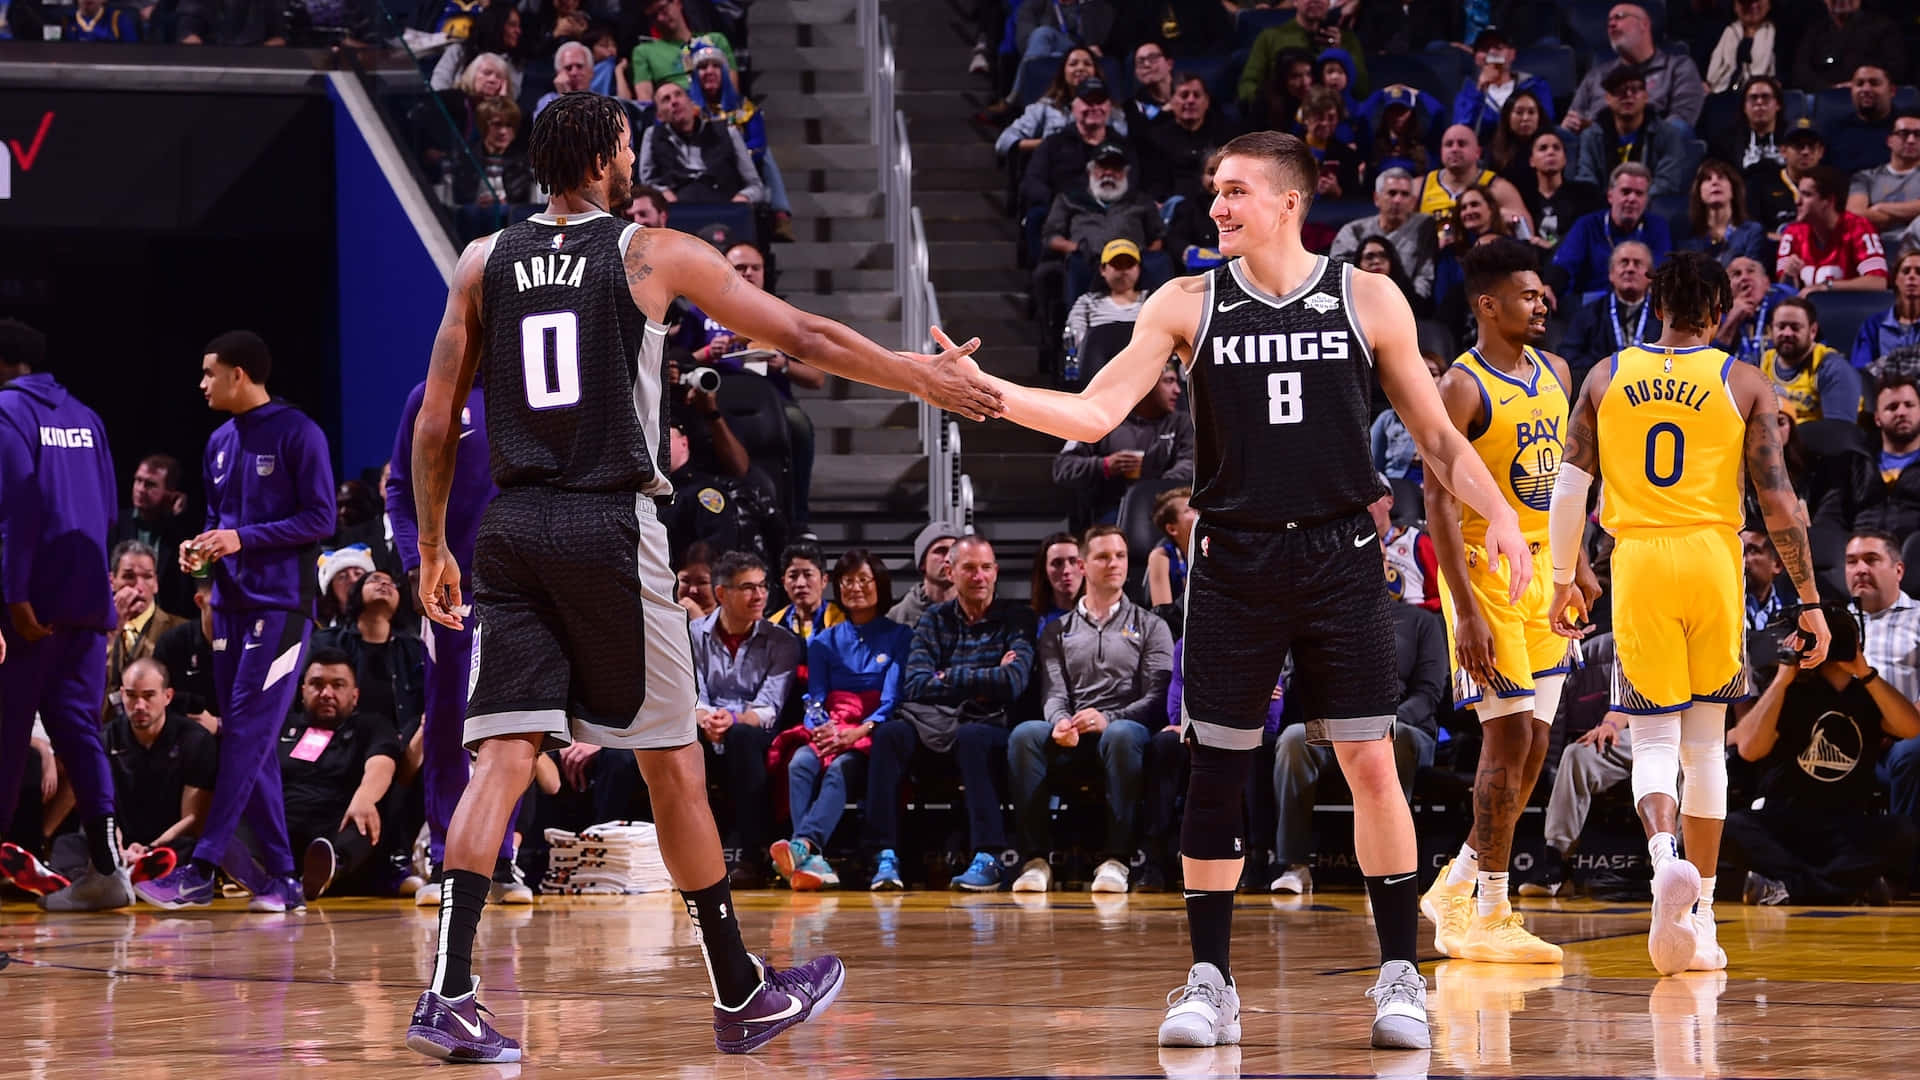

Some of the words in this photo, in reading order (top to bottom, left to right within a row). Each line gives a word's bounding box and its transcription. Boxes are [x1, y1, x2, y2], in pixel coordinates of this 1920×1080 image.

[514, 254, 587, 293] ARIZA
[520, 309, 582, 412] 0
[1213, 331, 1349, 365] KINGS
[1267, 372, 1304, 425] 8
[1624, 379, 1711, 412] RUSSELL
[40, 426, 94, 448] KINGS
[1517, 416, 1560, 448] BAY
[1537, 447, 1555, 474] 10
[1645, 422, 1685, 488] 0
